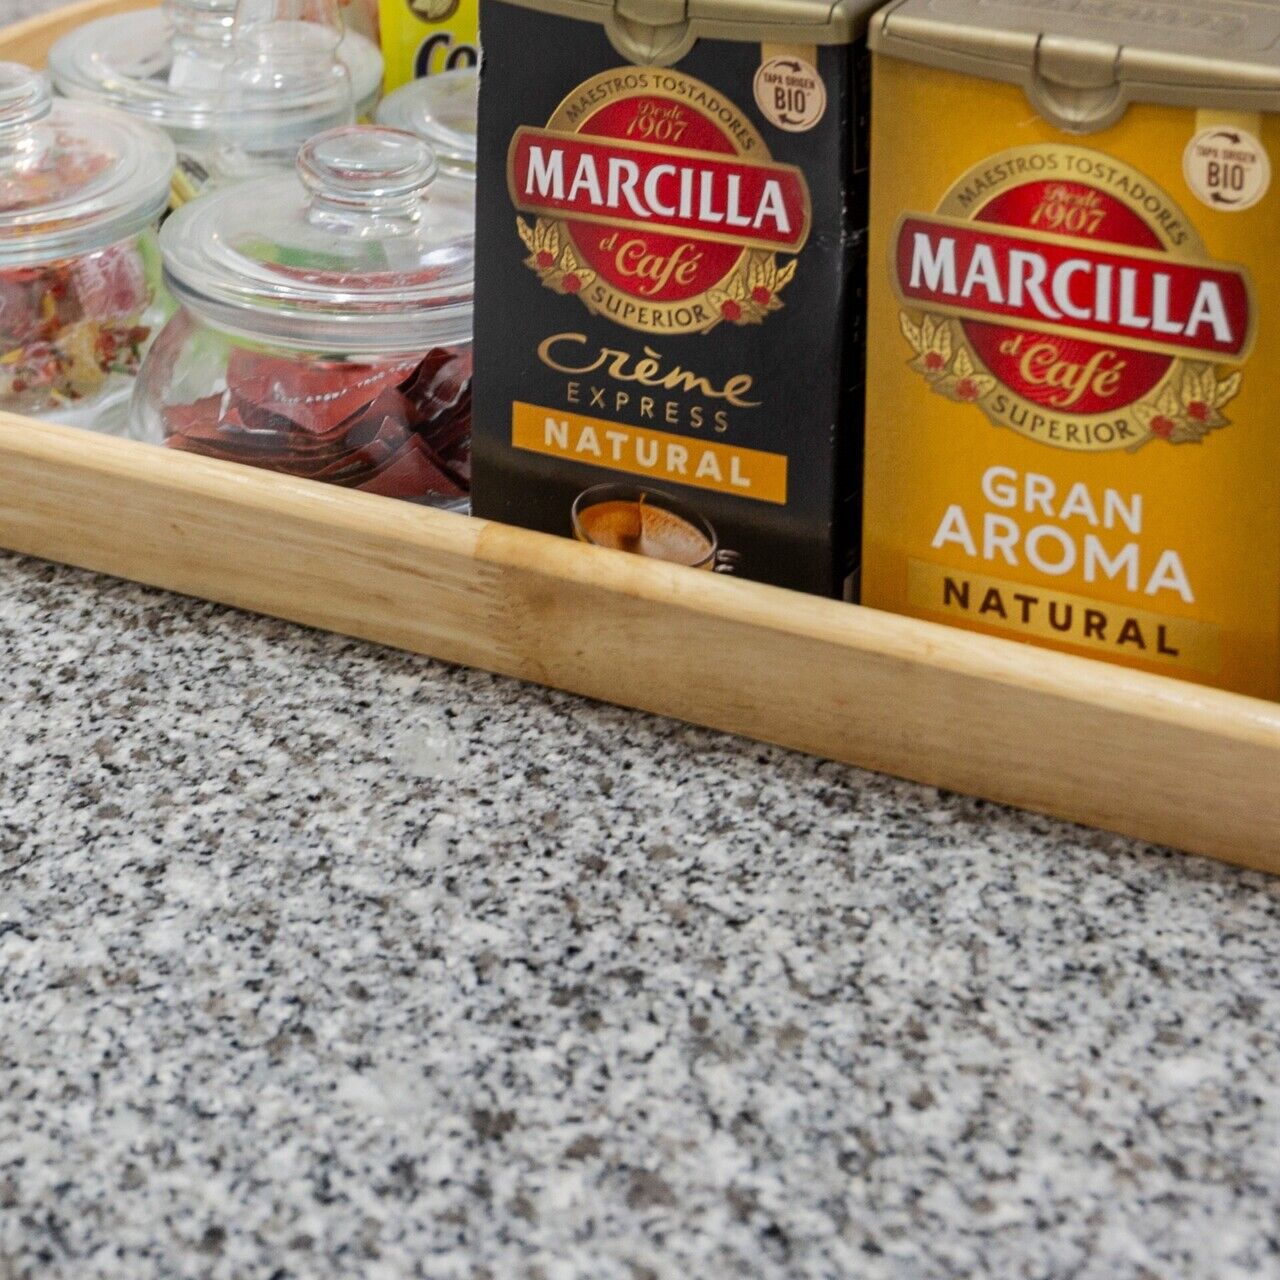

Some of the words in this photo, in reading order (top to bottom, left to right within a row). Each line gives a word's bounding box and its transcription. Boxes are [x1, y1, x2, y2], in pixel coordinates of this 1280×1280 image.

[565, 74, 649, 124] MAESTROS
[652, 74, 756, 152] TOSTADORES
[626, 116, 689, 143] 1907
[774, 86, 806, 114] BIO
[524, 145, 792, 235] MARCILLA
[957, 153, 1058, 209] MAESTROS
[1065, 155, 1190, 247] TOSTADORES
[1207, 162, 1245, 191] BIO
[1029, 204, 1107, 236] 1907
[615, 238, 704, 296] Café
[908, 232, 1234, 343] MARCILLA
[589, 285, 711, 329] SUPERIOR
[537, 332, 763, 408] Crème
[1018, 342, 1127, 408] Café
[566, 380, 729, 434] EXPRESS
[991, 394, 1137, 445] SUPERIOR
[543, 416, 752, 489] NATURAL
[981, 465, 1143, 535] GRAN
[930, 503, 1196, 604] AROMA
[942, 577, 1180, 657] NATURAL
